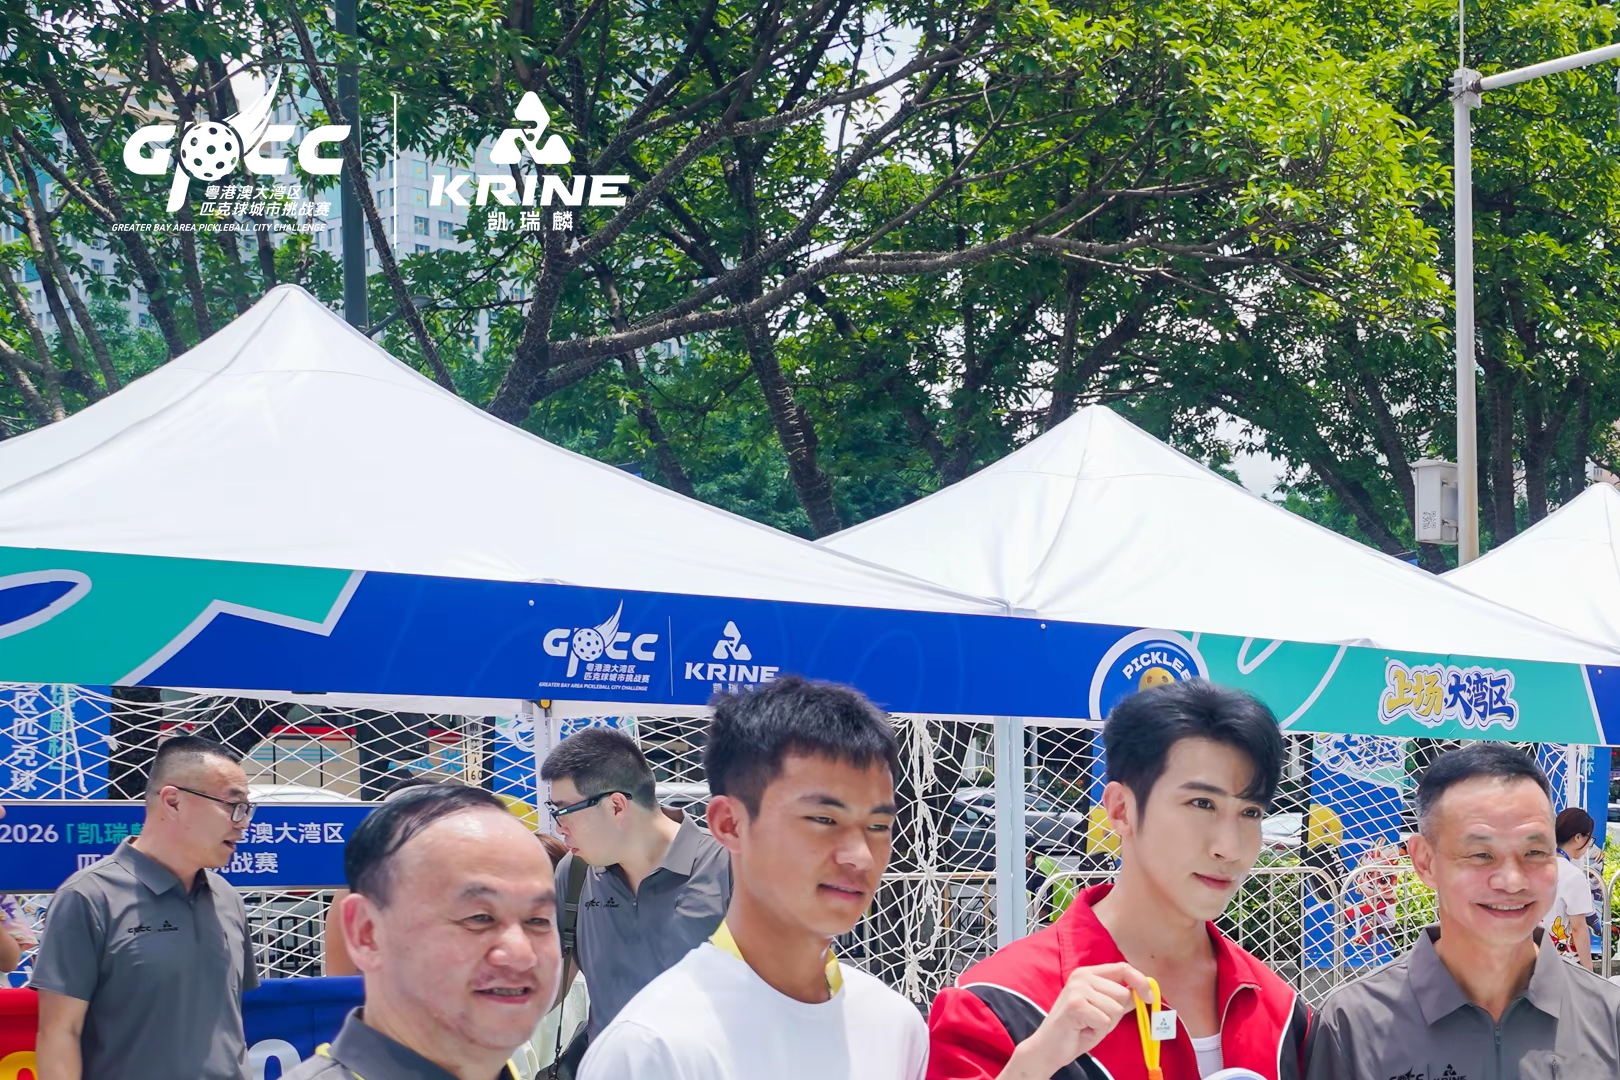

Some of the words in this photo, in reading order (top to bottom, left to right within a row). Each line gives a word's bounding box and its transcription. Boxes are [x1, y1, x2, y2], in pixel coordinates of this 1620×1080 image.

[585, 663, 637, 674] 粤港澳大湾区
[684, 662, 780, 683] KRINE
[583, 672, 651, 685] 匹克球城市挑战赛
